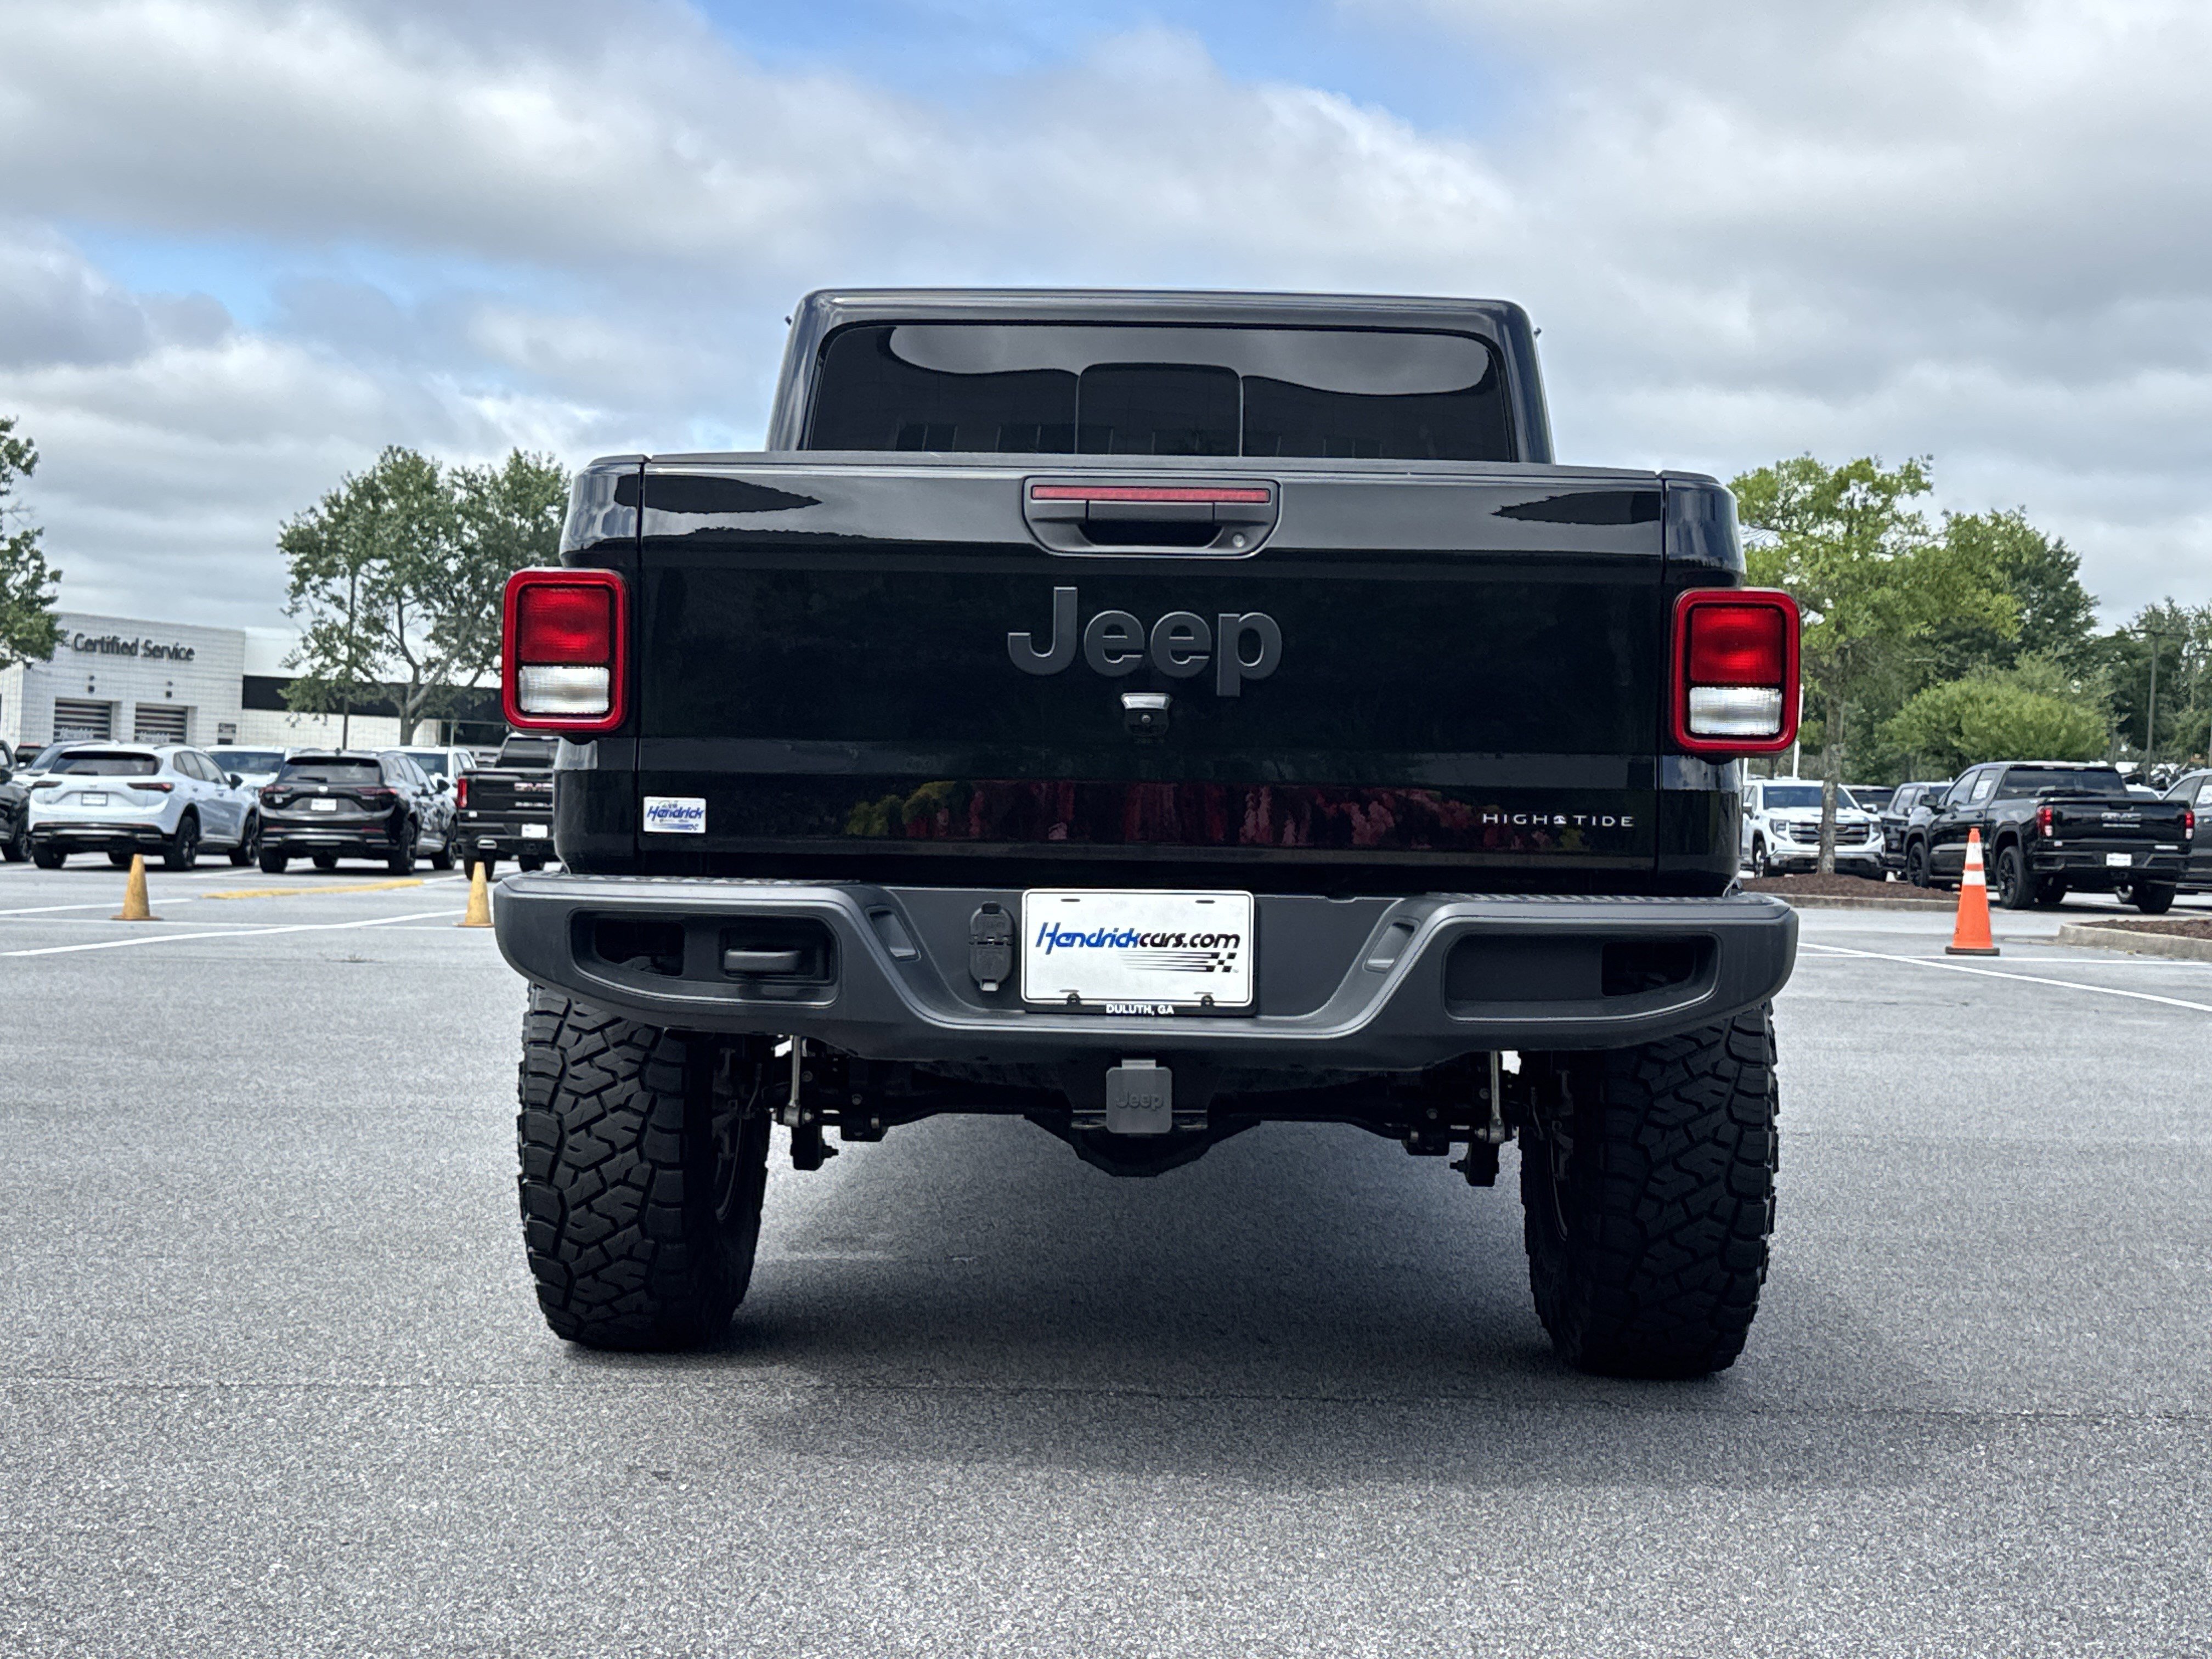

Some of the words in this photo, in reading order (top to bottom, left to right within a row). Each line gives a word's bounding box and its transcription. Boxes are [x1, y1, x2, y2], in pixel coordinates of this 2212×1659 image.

[74, 633, 139, 656] Certified
[142, 639, 195, 661] Service
[1007, 586, 1283, 697] Jeep
[647, 806, 704, 822] Hendrick
[1482, 813, 1548, 825] HIGH
[1573, 815, 1634, 827] TIDE
[1035, 922, 1240, 955] Hendrickcars.com
[1105, 1003, 1155, 1015] DULUTH,
[1157, 1005, 1175, 1014] GA
[1115, 1088, 1164, 1111] Jeep
